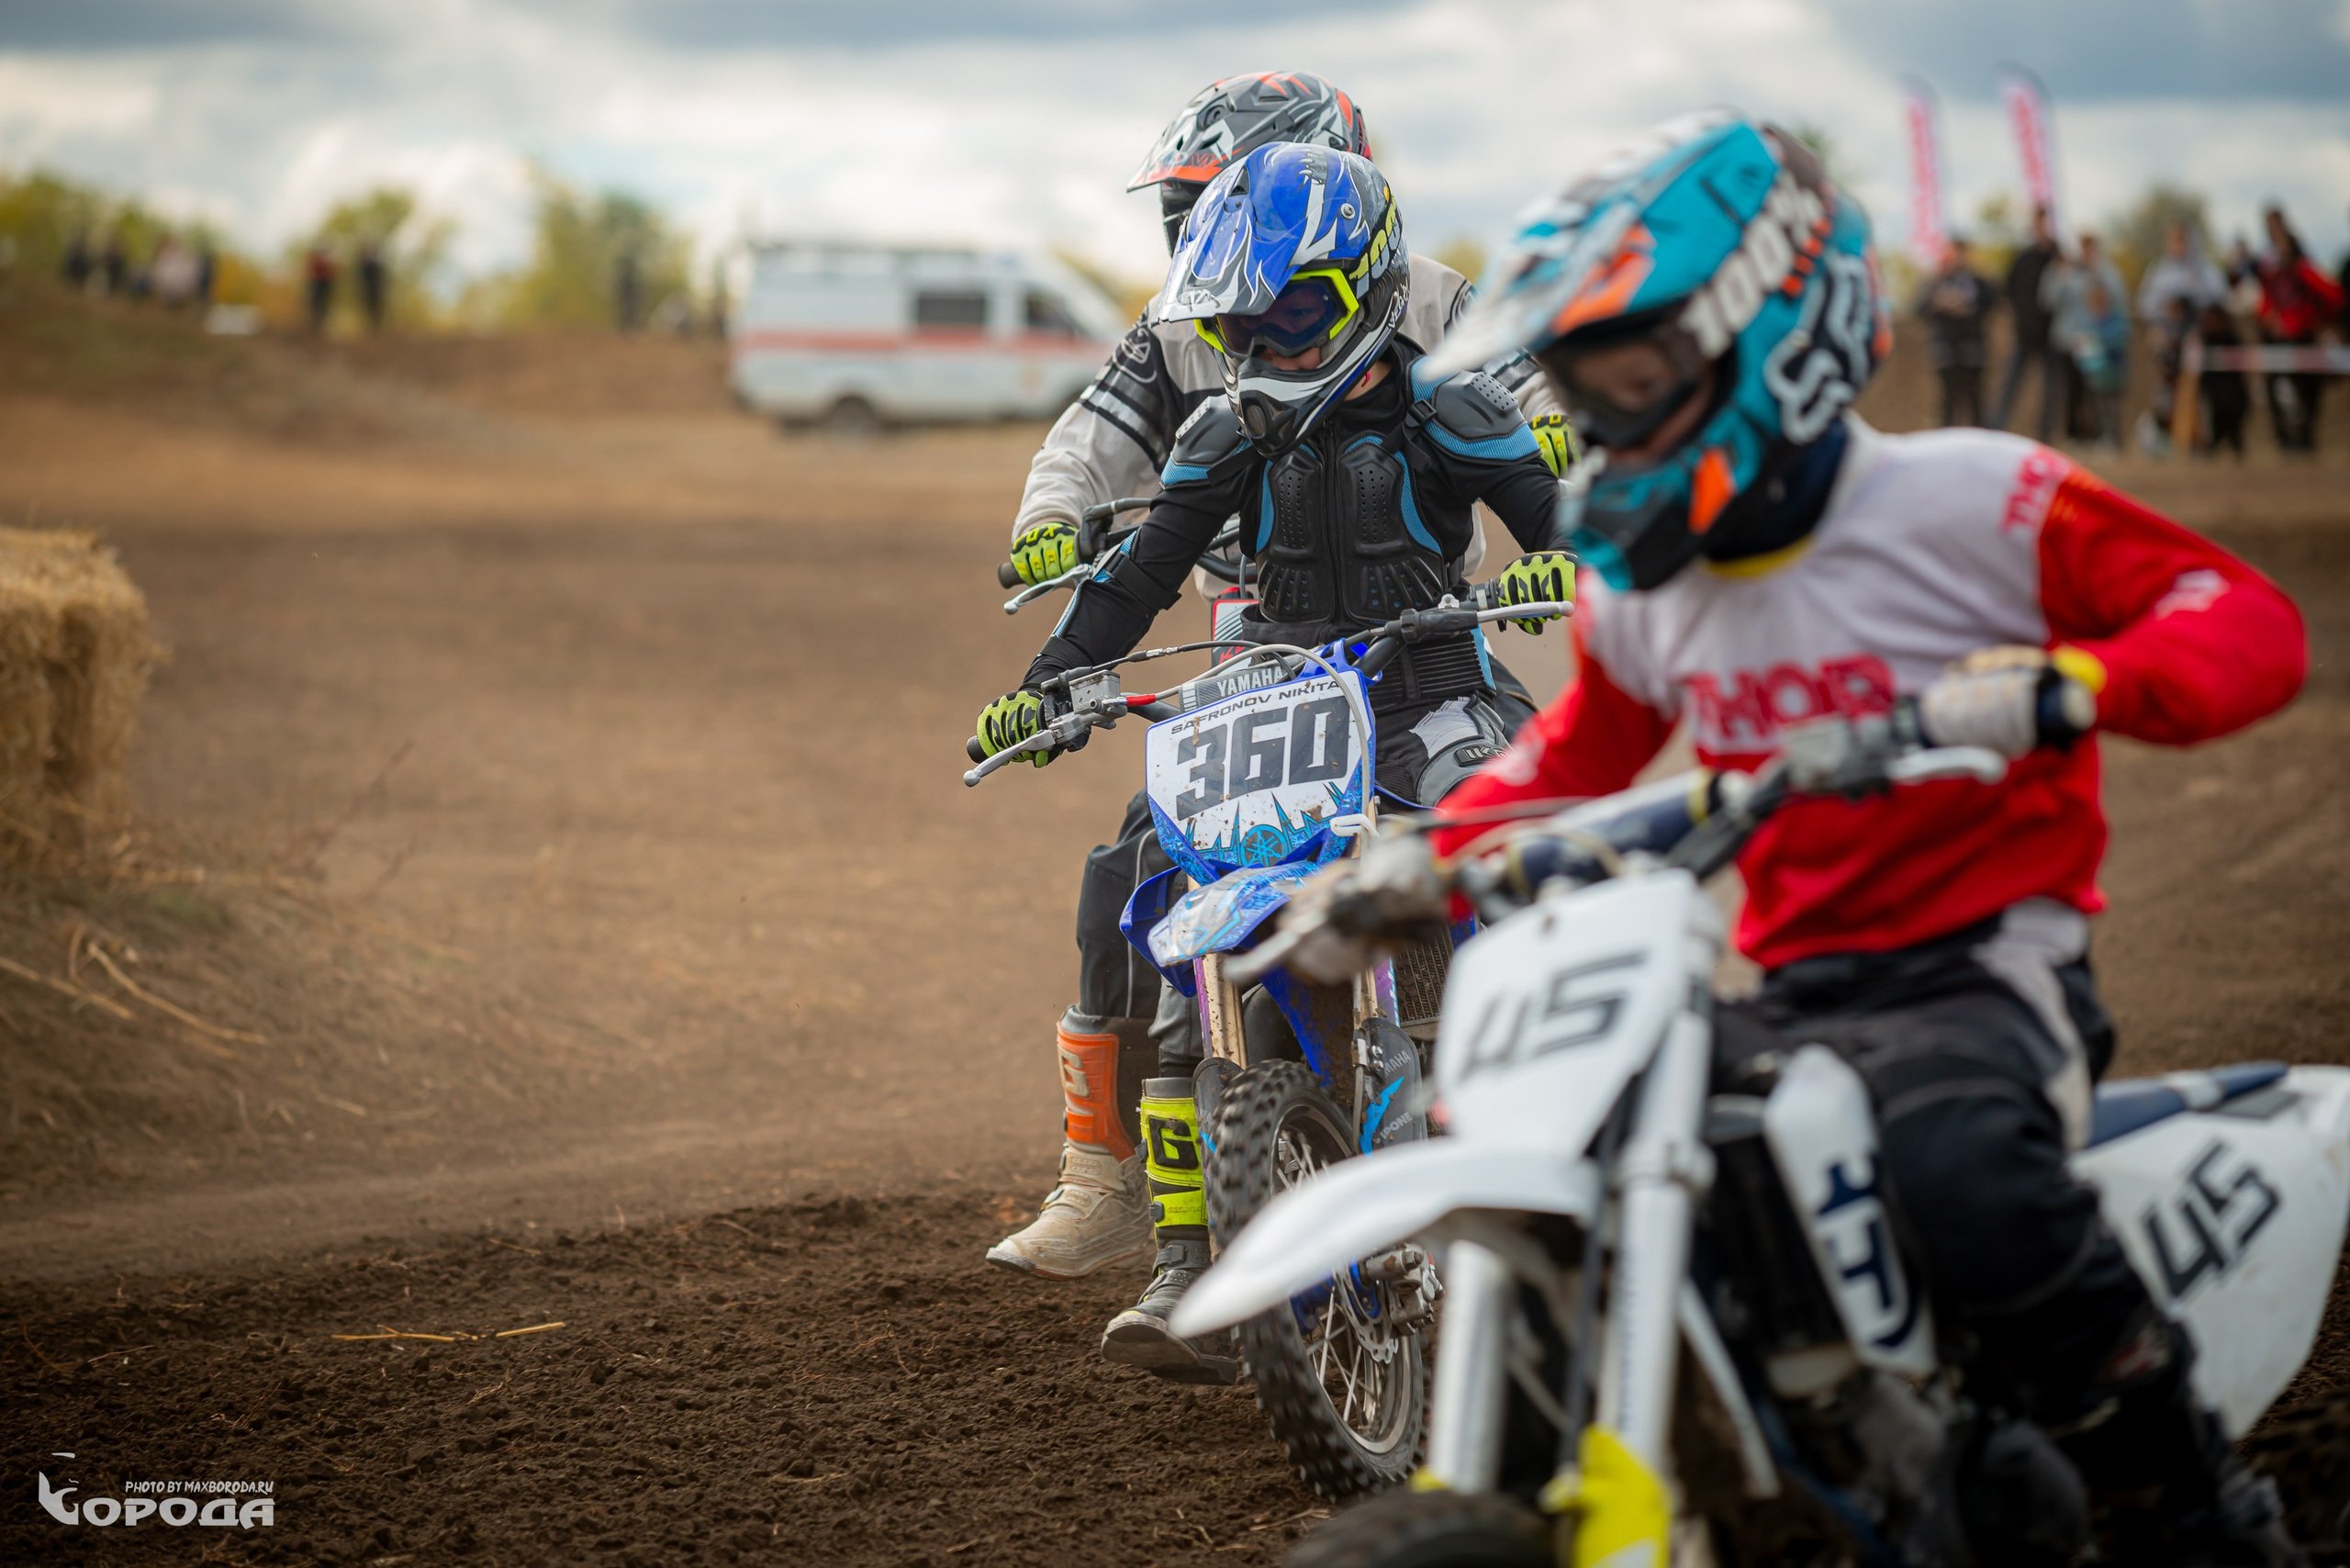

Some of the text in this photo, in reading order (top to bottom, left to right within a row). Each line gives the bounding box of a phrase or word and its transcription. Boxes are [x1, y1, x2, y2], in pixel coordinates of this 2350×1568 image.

[1171, 679, 1341, 734] SAFRONOV NIKITA
[1217, 666, 1284, 699] YAMAHA
[1176, 695, 1352, 821] 360
[1382, 1049, 1412, 1080] MAHA
[2141, 1139, 2282, 1297] 45
